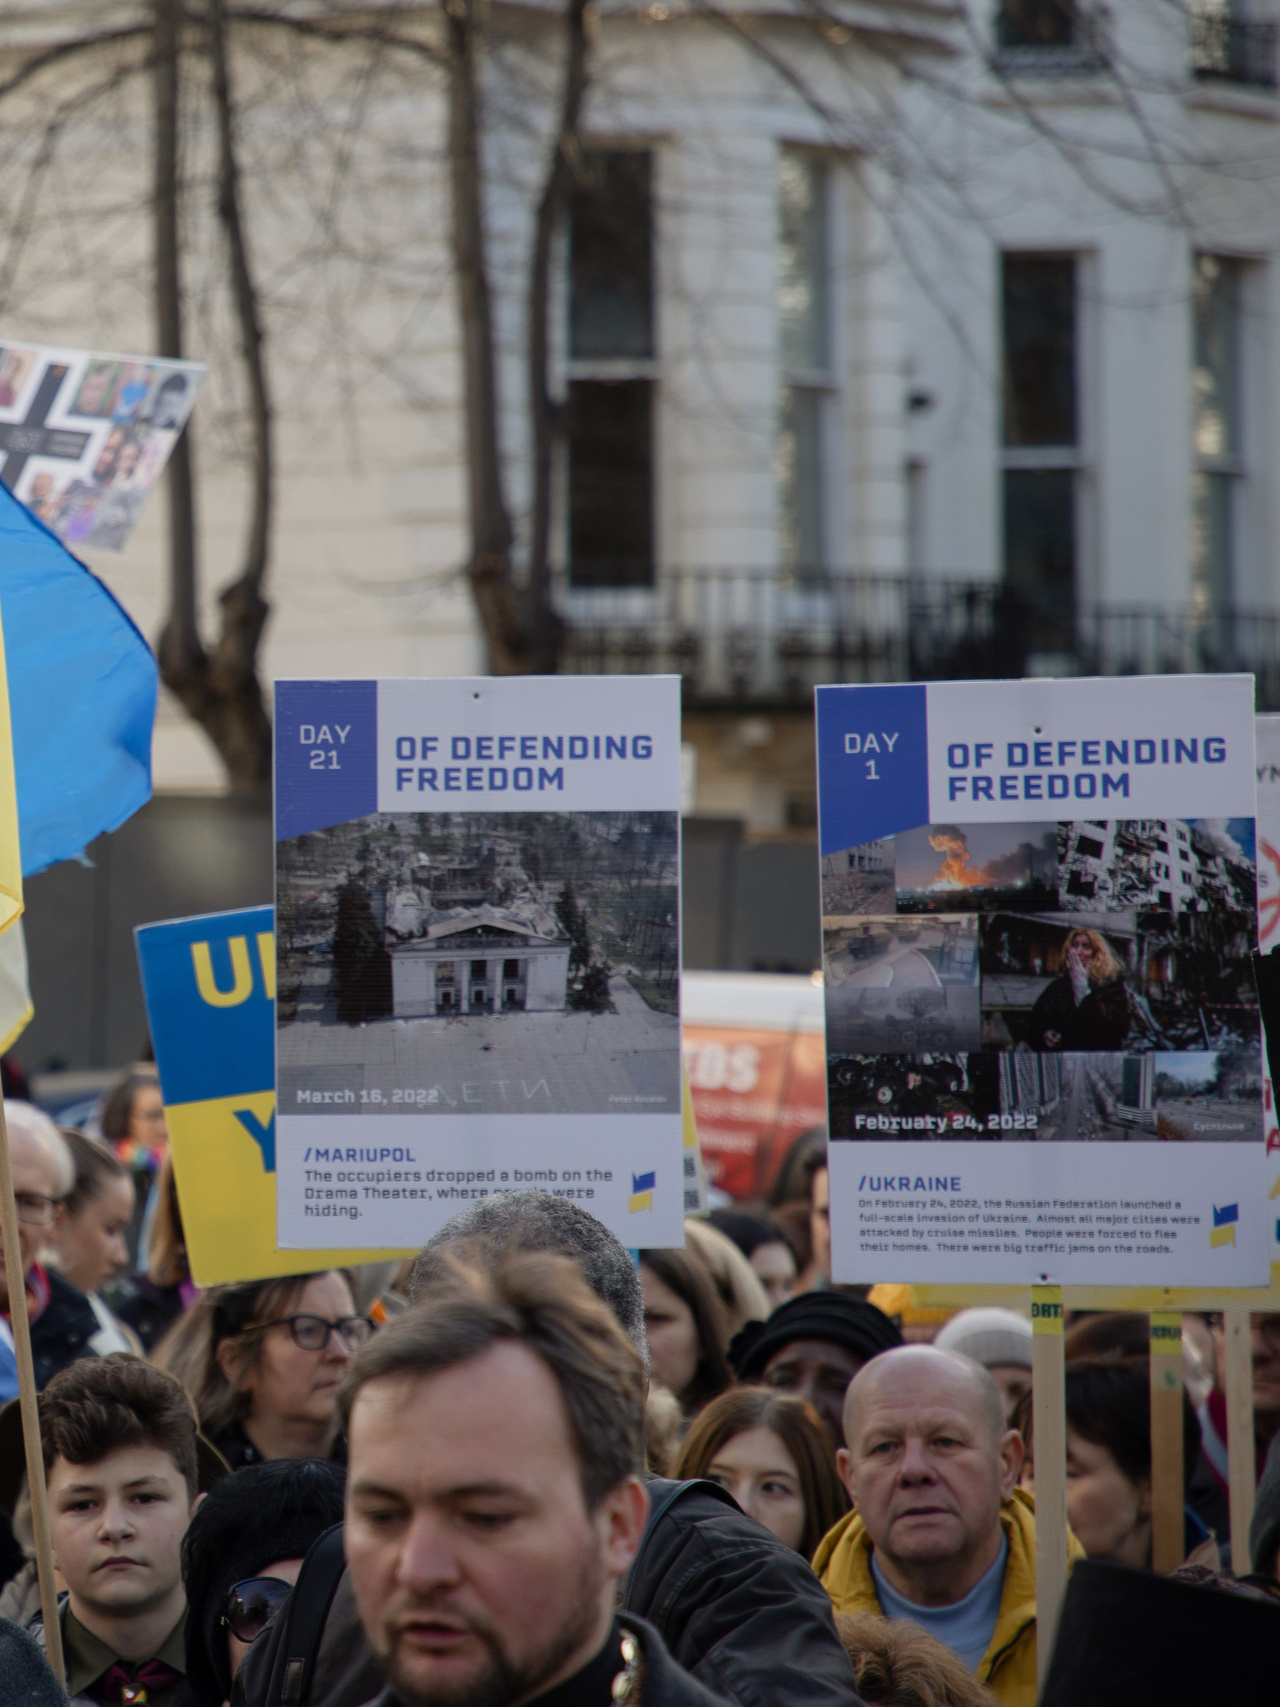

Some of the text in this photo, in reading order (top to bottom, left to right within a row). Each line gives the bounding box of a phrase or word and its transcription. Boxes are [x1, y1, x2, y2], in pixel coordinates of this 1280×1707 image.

[299, 724, 352, 745] DAY
[844, 731, 900, 754] DAY
[395, 735, 653, 761] OF DEFENDING
[947, 736, 1226, 769] OF DEFENDING
[309, 749, 342, 770] 21
[865, 758, 880, 780] 1
[396, 766, 564, 792] FREEDOM
[948, 772, 1130, 801] FREEDOM
[296, 1088, 439, 1106] March 16, 2022
[855, 1113, 1038, 1133] February 24, 2022
[304, 1147, 416, 1163] /MARIUPOL
[304, 1169, 613, 1184] The occupiers dropped a bomb on the
[858, 1175, 961, 1192] /UKRAINE
[304, 1187, 358, 1200] Drama
[362, 1187, 432, 1201] Theater,
[552, 1188, 595, 1200] were
[304, 1203, 363, 1220] hiding.
[858, 1199, 1182, 1210] On February 24, 2022, the Russian Federation launched a
[859, 1213, 1201, 1226] full-scale invasion of Ukraine. Almost all major cities were
[859, 1228, 1178, 1240] attacked by cruise missiles. People were forced to flee
[859, 1242, 1173, 1255] their homes. There were big traffic jams on the roads.
